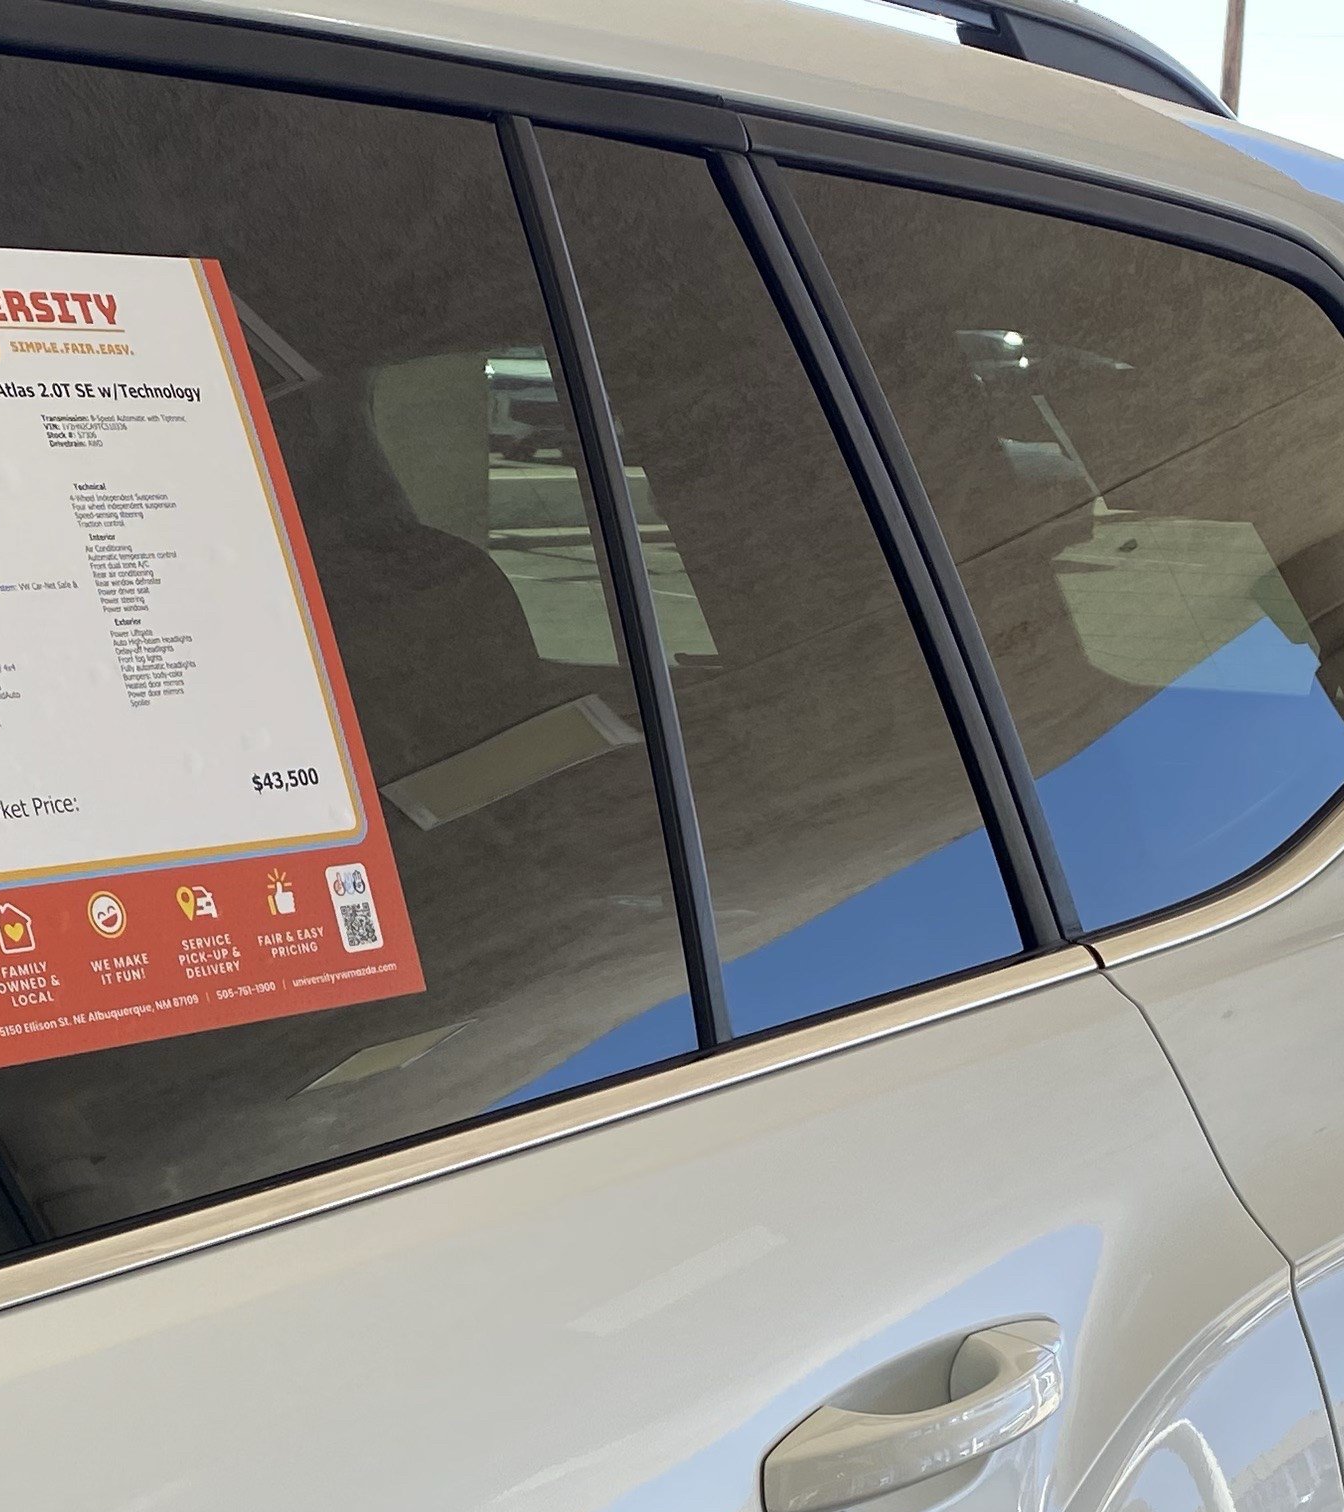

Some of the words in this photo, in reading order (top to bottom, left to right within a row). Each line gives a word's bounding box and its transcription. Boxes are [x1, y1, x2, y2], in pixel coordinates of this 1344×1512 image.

[38, 383, 71, 399] 2.0T
[75, 383, 96, 399] SE
[98, 382, 201, 402] w/Technology
[41, 414, 88, 422] Transmission:
[89, 533, 115, 541] Interior
[95, 545, 132, 553] Conditioning
[114, 618, 141, 626] Exterior
[251, 767, 319, 795] $43,500
[32, 795, 80, 817] Price:
[182, 934, 231, 951] SERVICE
[258, 932, 283, 947] FAIR
[286, 930, 294, 942] &
[297, 926, 325, 941] EASY
[178, 949, 229, 966] PICK-UP
[232, 946, 241, 958] &
[271, 942, 318, 959] PRICING
[0, 961, 48, 979] FAMILY
[90, 960, 110, 973] WE
[113, 953, 149, 969] MAKE
[185, 961, 240, 980] DELIVERY
[50, 974, 60, 987] &
[101, 974, 112, 985] IT
[115, 968, 146, 984] FUN!
[11, 991, 55, 1008] LOCAL
[24, 1019, 57, 1033] Ellison
[58, 1017, 71, 1028] St.
[73, 1014, 86, 1025] NE
[88, 1003, 155, 1022] Albuquerque,
[155, 999, 171, 1011] NM
[173, 994, 199, 1008] 87109
